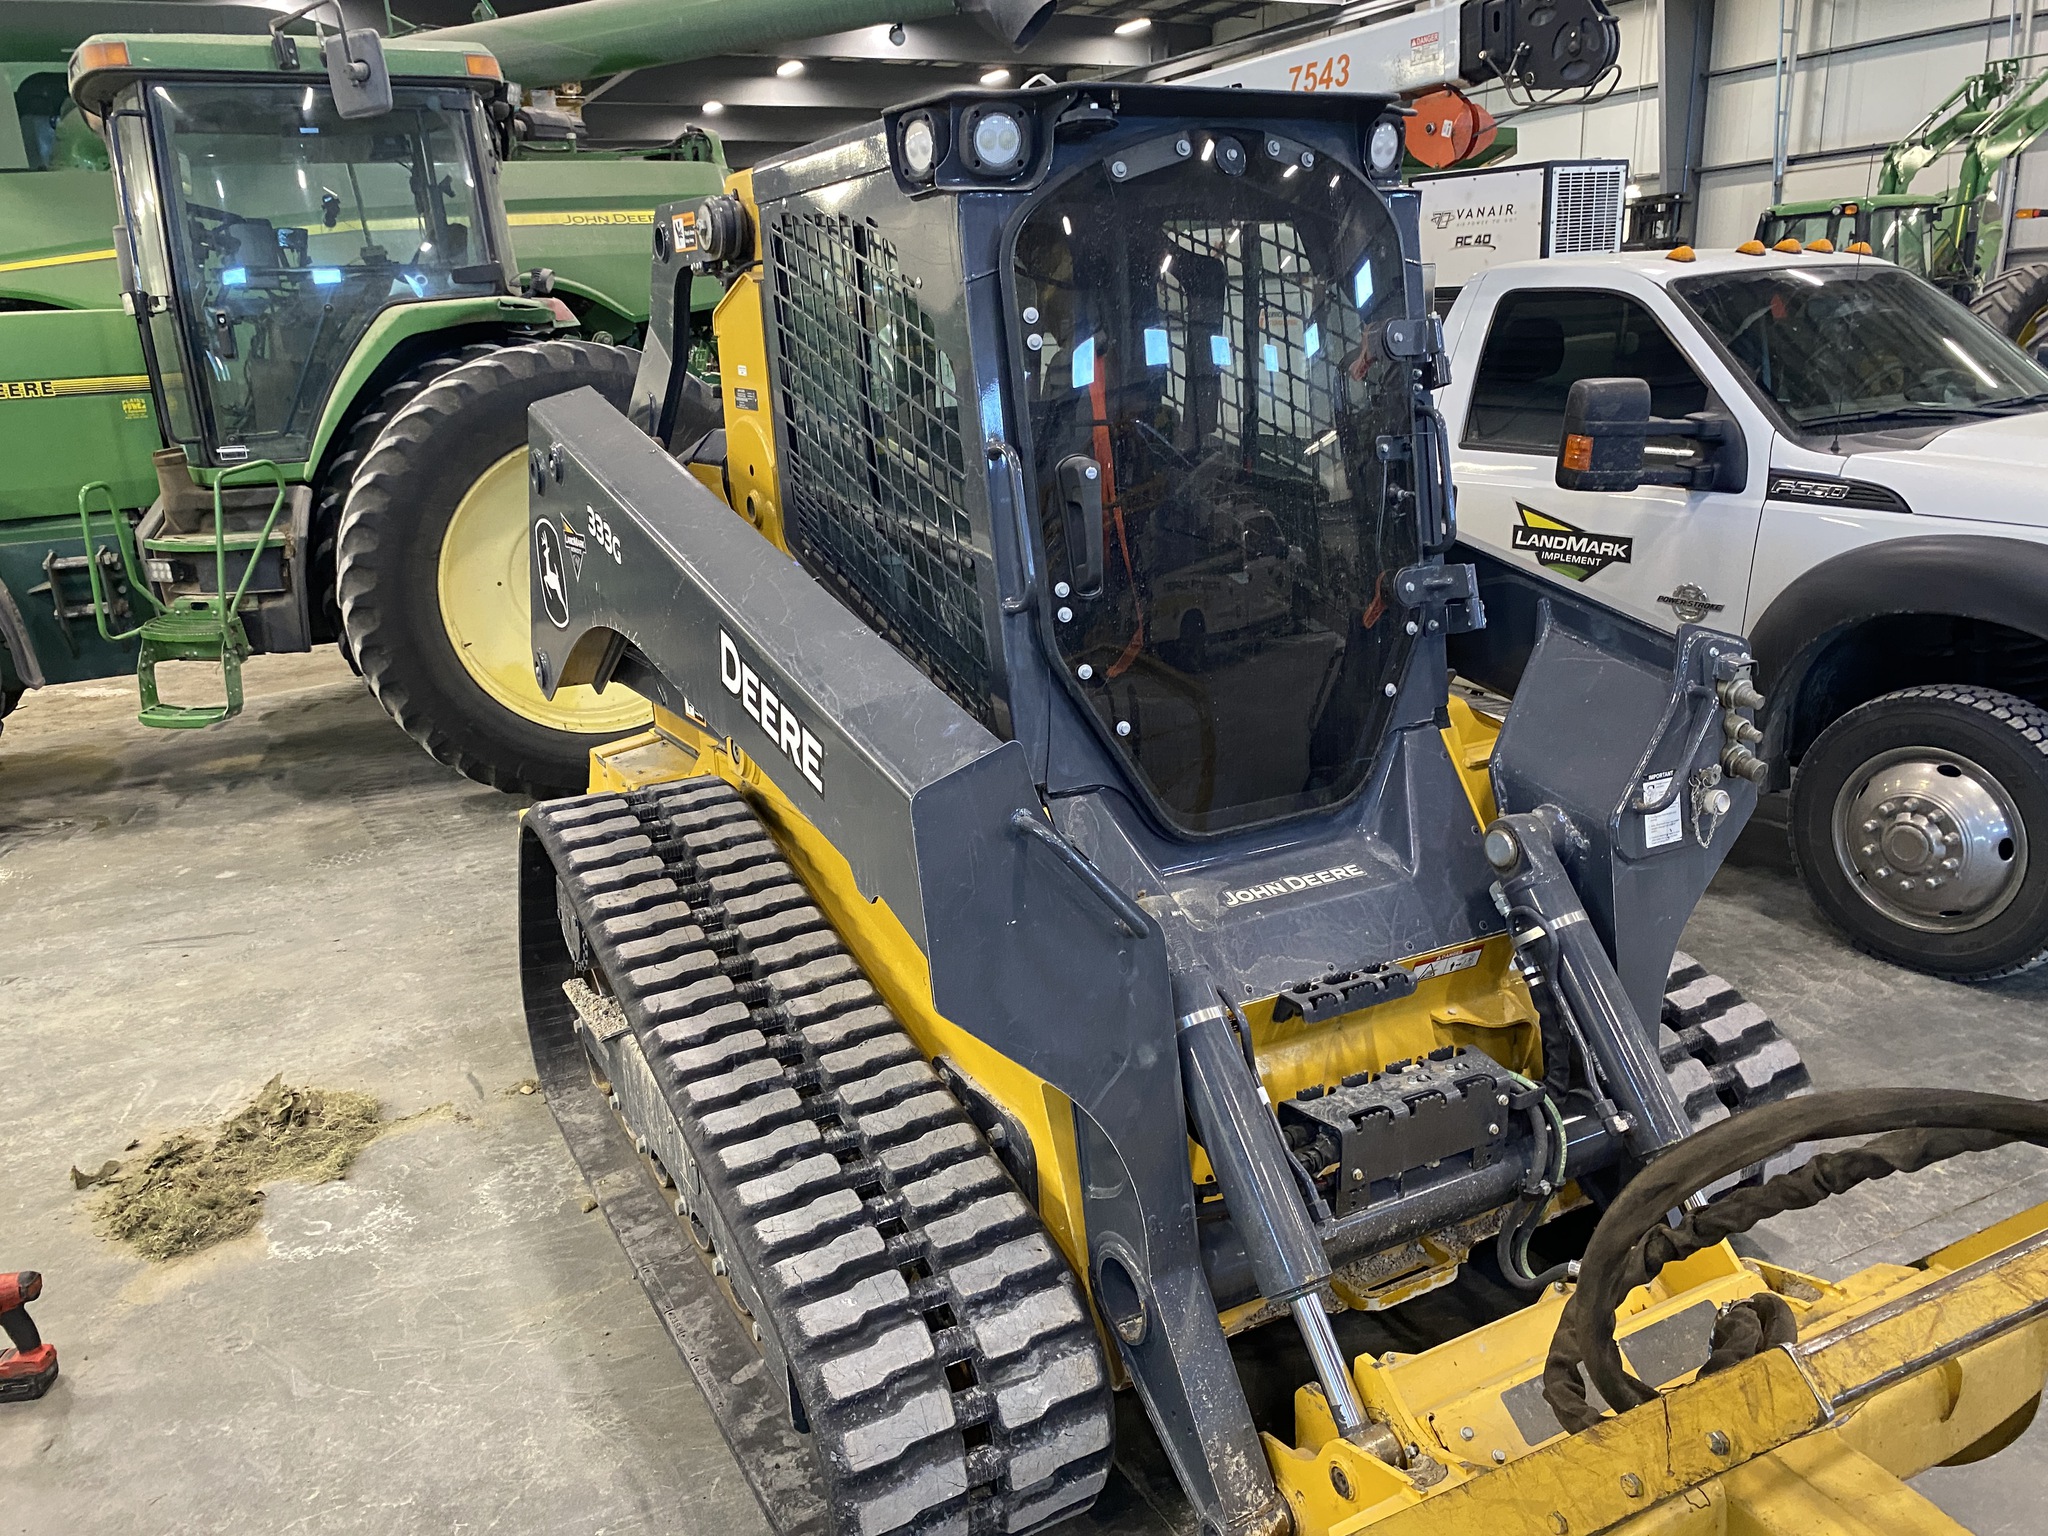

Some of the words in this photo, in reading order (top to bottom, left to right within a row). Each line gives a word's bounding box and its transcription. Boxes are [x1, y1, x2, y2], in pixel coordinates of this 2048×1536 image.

[1289, 53, 1350, 92] 7543
[563, 214, 609, 224] JOHN
[1457, 204, 1514, 220] VANAIR
[1474, 234, 1492, 245] 40
[586, 504, 622, 565] 333G
[1541, 551, 1602, 567] IMPLEMENT
[1657, 595, 1686, 606] POWER
[1687, 600, 1722, 611] STROKE
[720, 628, 823, 794] DEERE
[1648, 770, 1674, 780] IMPORTANT
[1226, 881, 1288, 906] JOHN
[1283, 864, 1364, 890] DEERE
